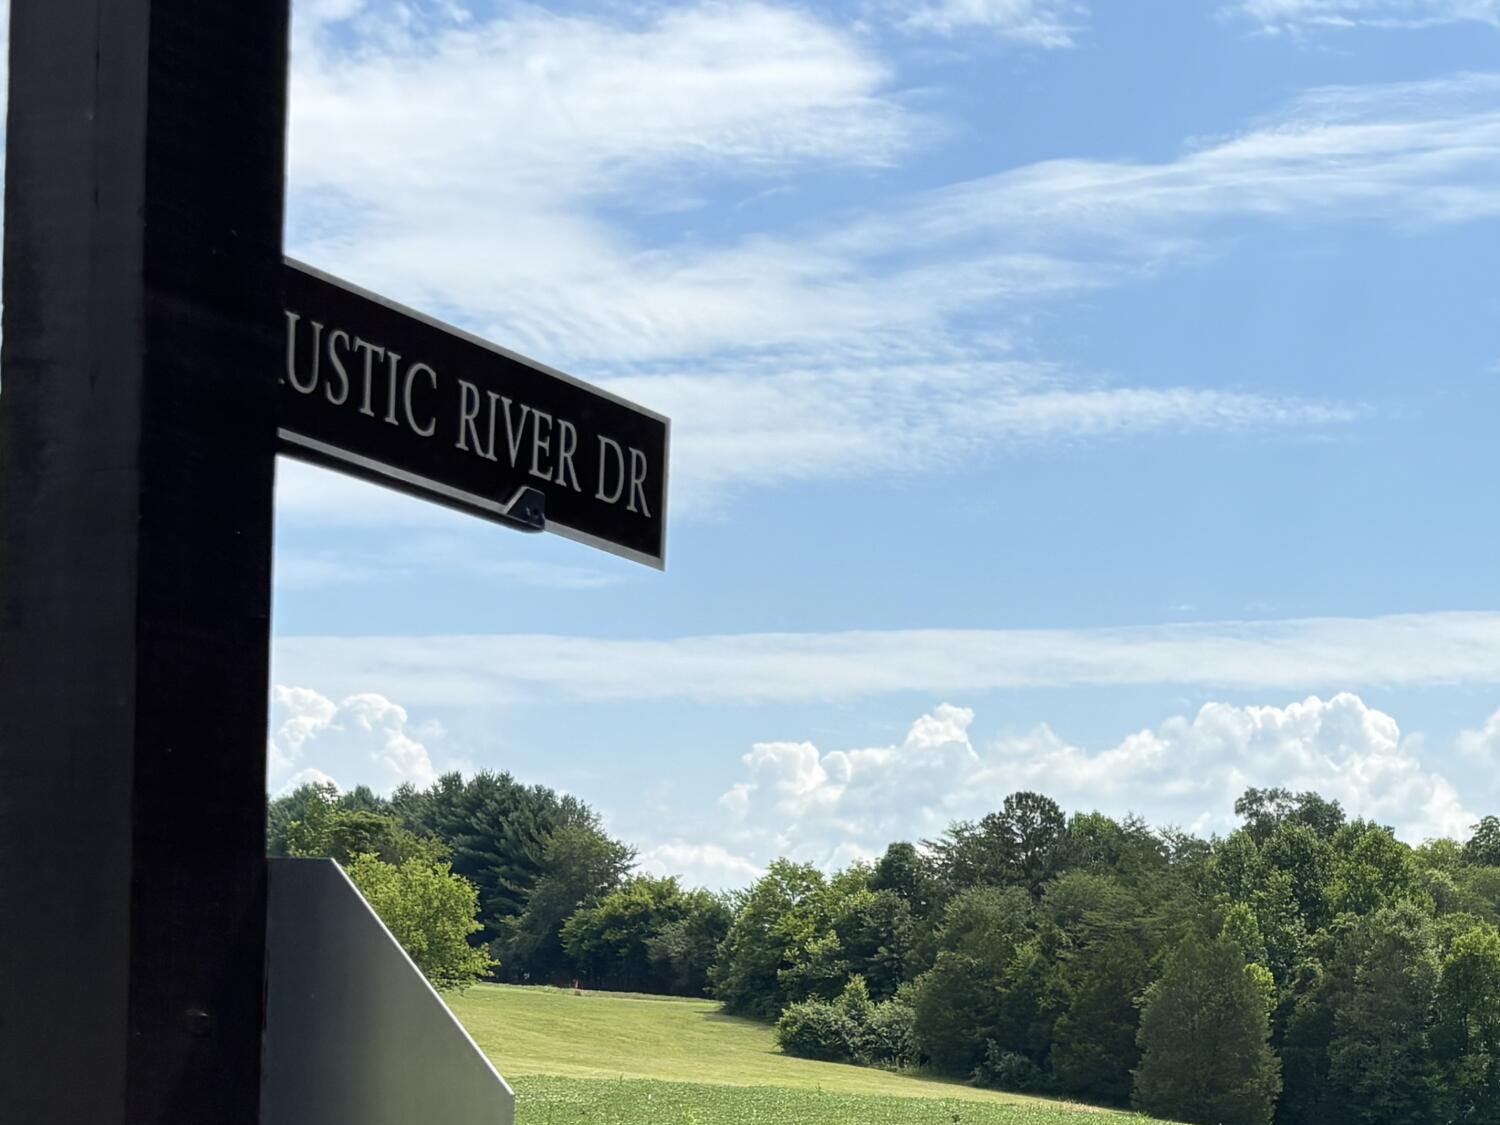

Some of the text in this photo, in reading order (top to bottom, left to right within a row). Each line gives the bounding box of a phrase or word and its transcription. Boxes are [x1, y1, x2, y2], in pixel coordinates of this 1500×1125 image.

[278, 311, 652, 518] USTIC RIVER DR
